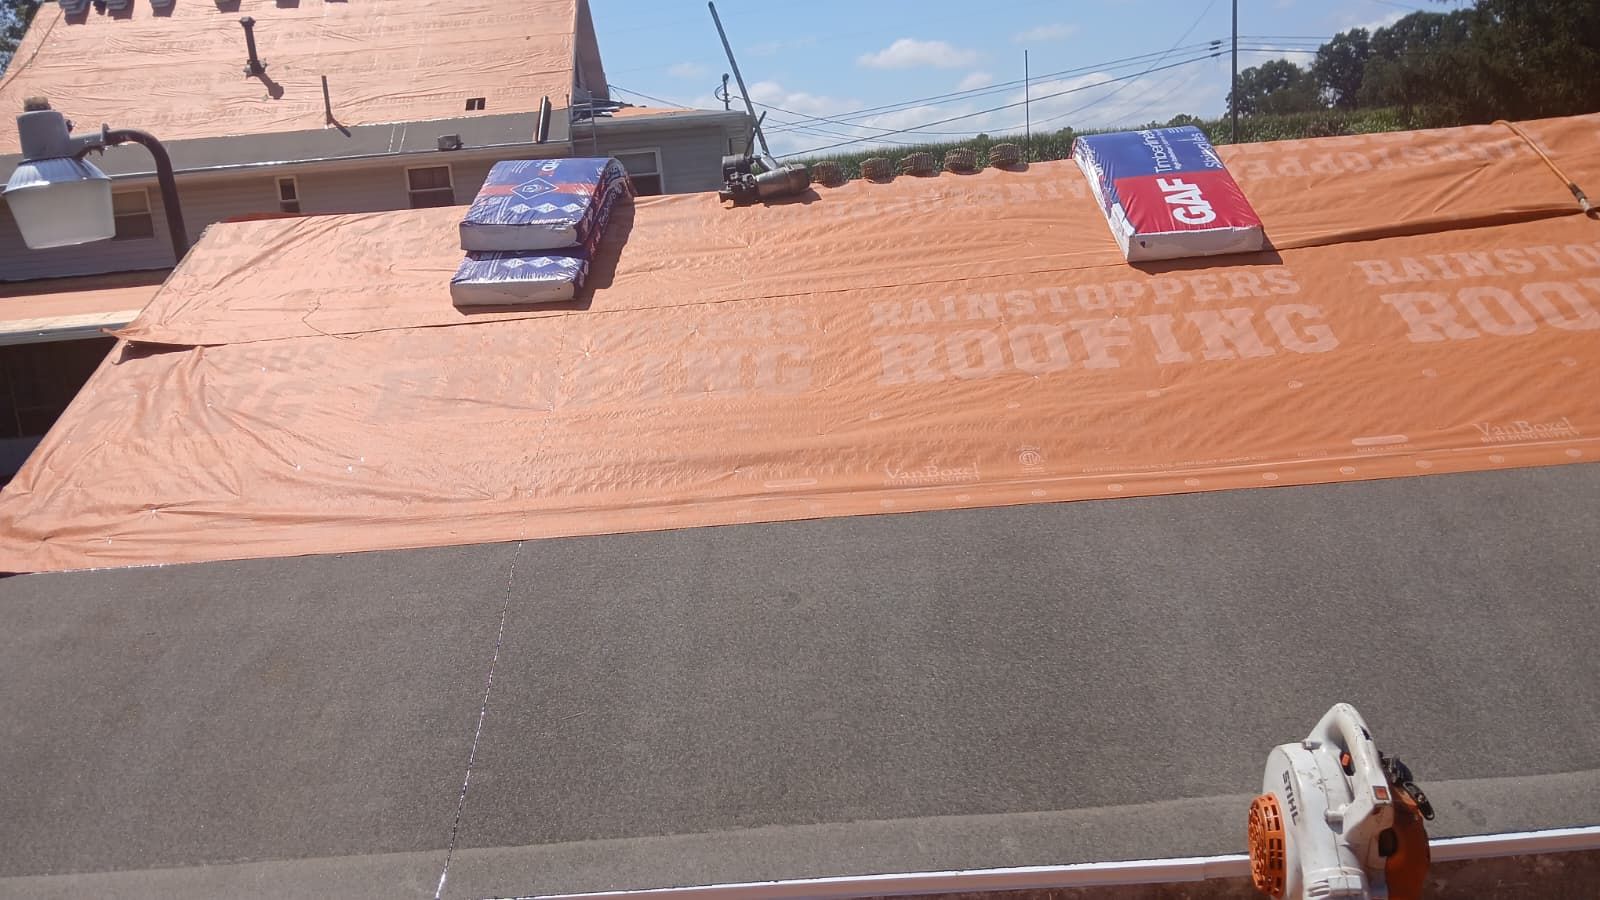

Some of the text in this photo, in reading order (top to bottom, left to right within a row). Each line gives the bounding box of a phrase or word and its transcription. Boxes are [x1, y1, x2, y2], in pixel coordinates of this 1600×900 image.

[1156, 177, 1217, 225] GAF
[1353, 241, 1600, 285] RAINSTO
[872, 267, 1301, 327] RAINSTOPPERS
[873, 303, 1340, 387] ROOFING
[1472, 416, 1580, 437] VanBoxel
[1282, 769, 1298, 826] STIHL
